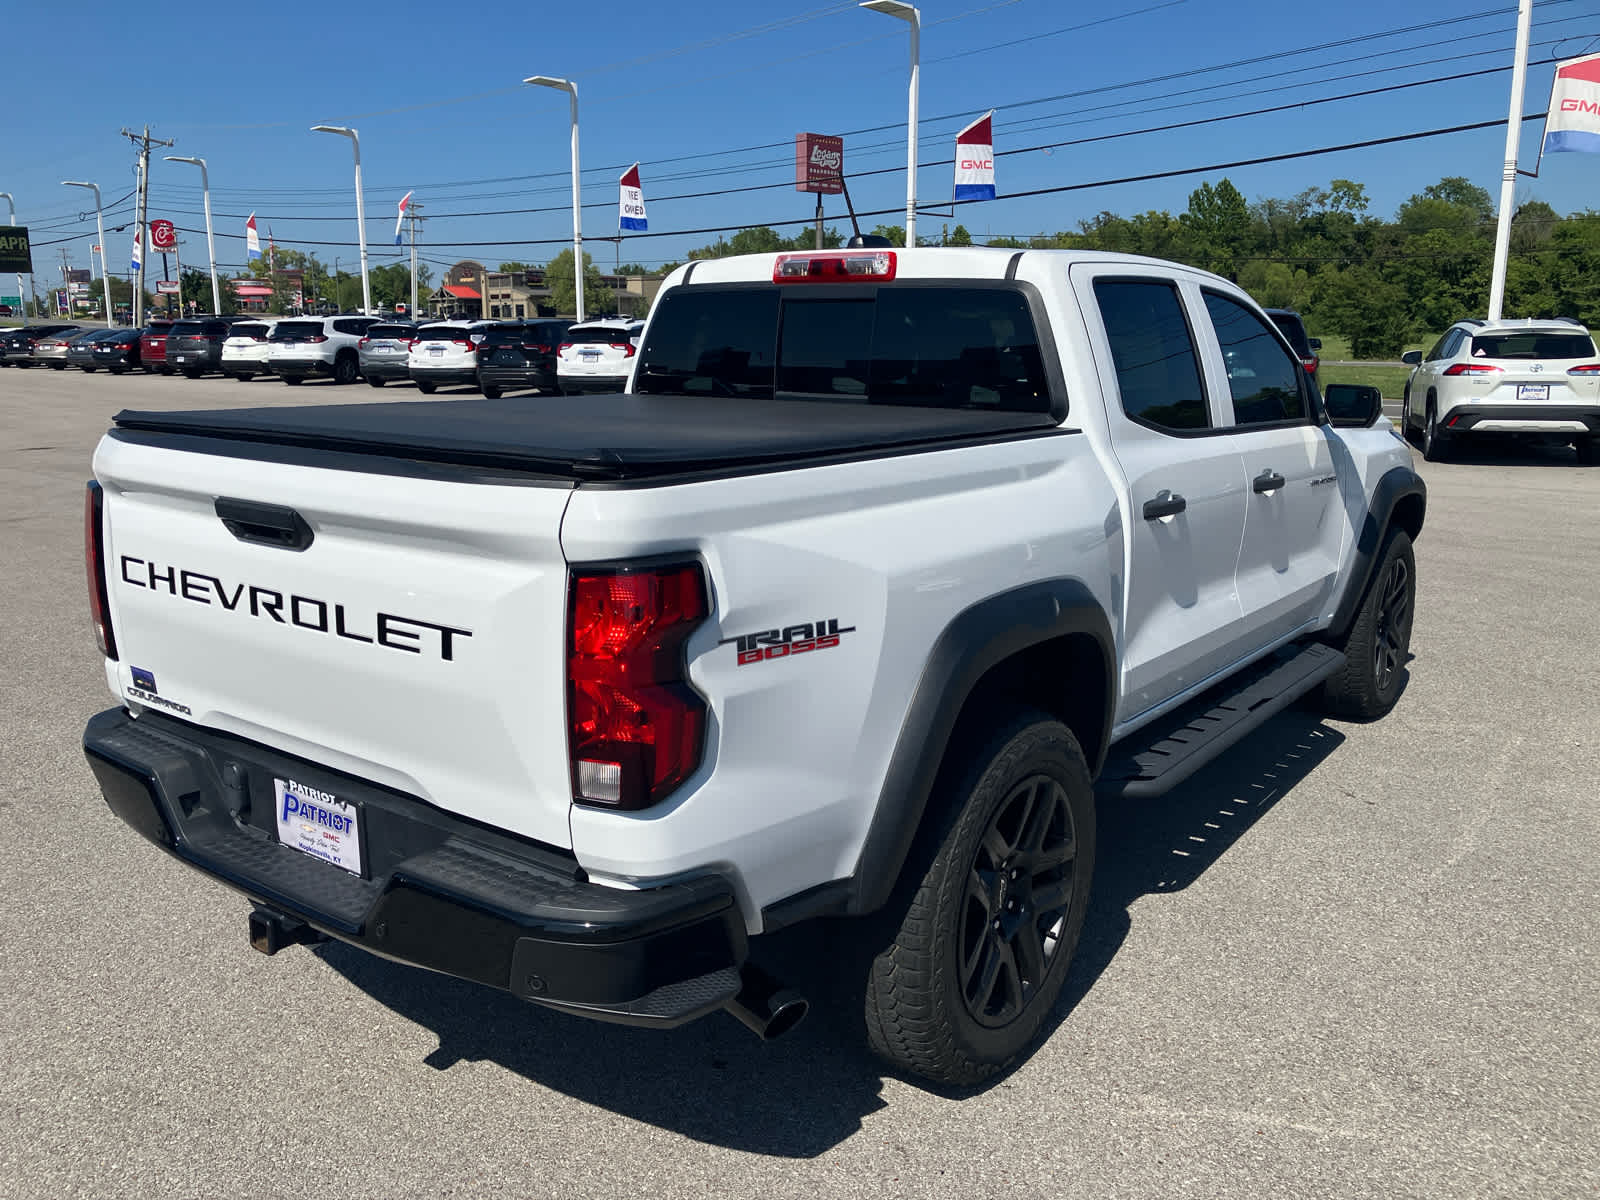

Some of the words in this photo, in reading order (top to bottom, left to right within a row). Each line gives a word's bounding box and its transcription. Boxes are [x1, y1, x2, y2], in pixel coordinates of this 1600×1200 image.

[1560, 98, 1600, 115] GM
[961, 159, 992, 170] GMC
[121, 555, 473, 661] CHEVROLET
[718, 618, 856, 651] TRAIL
[737, 634, 840, 666] BOSS
[288, 780, 336, 806] PATRIOT
[282, 792, 353, 834] PATRIOT
[322, 831, 341, 843] GMC
